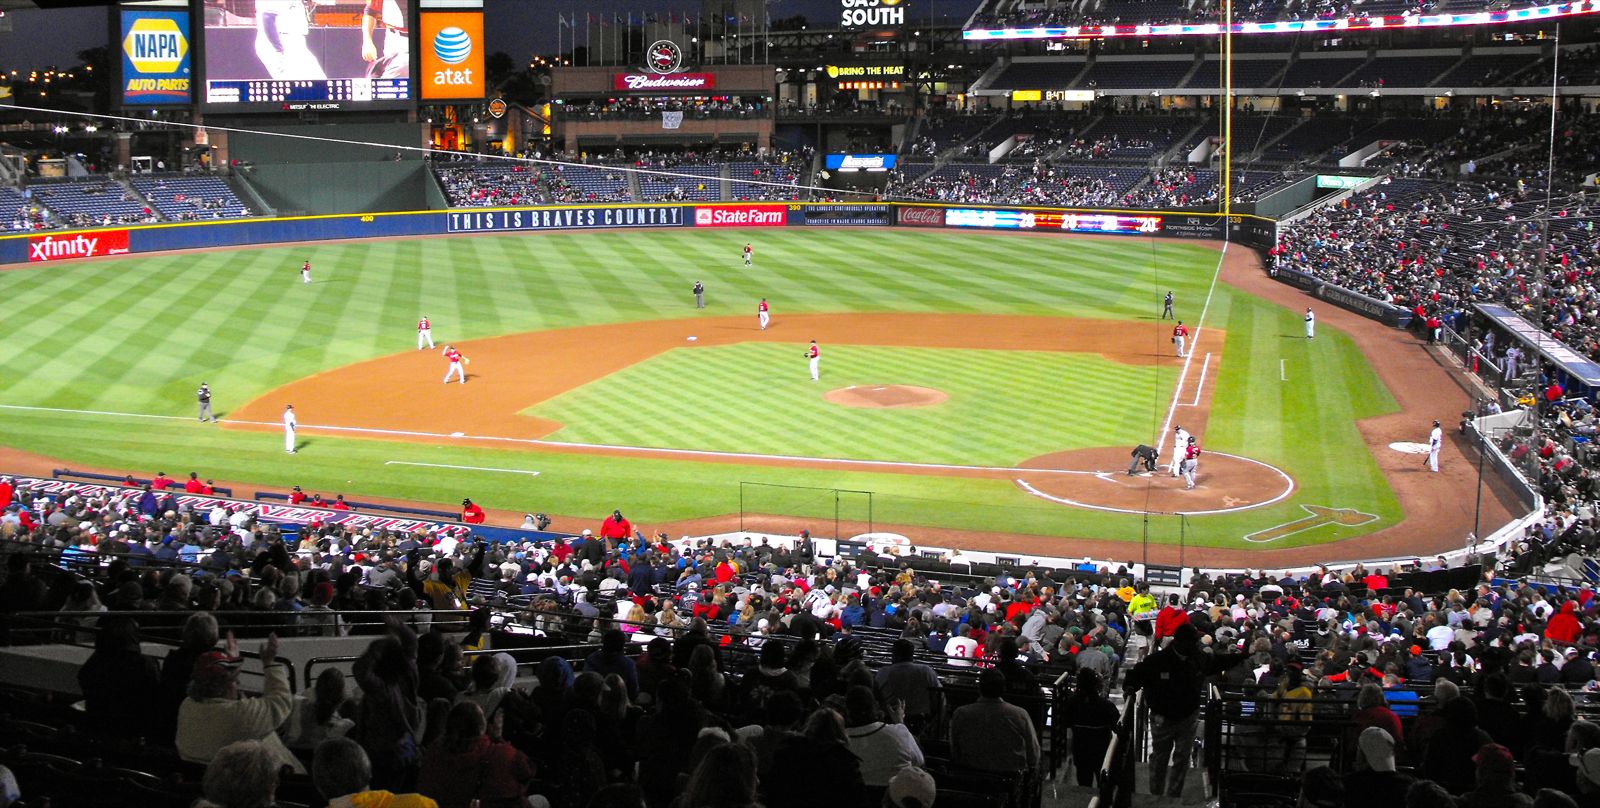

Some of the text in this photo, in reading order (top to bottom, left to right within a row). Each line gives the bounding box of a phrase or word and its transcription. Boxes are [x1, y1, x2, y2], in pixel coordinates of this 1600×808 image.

[841, 7, 904, 26] SOUTH
[135, 34, 178, 58] NAPA
[433, 68, 473, 85] at&t
[839, 66, 904, 76] BRING THE HEAT
[126, 79, 189, 91] AUTO PARTS
[624, 75, 704, 89] Budweiser
[452, 208, 678, 230] THIS IS BRAVES COUNTRY
[902, 207, 943, 224] Coca-Cola
[31, 235, 97, 260] xfinity
[331, 513, 473, 536] FIELD
